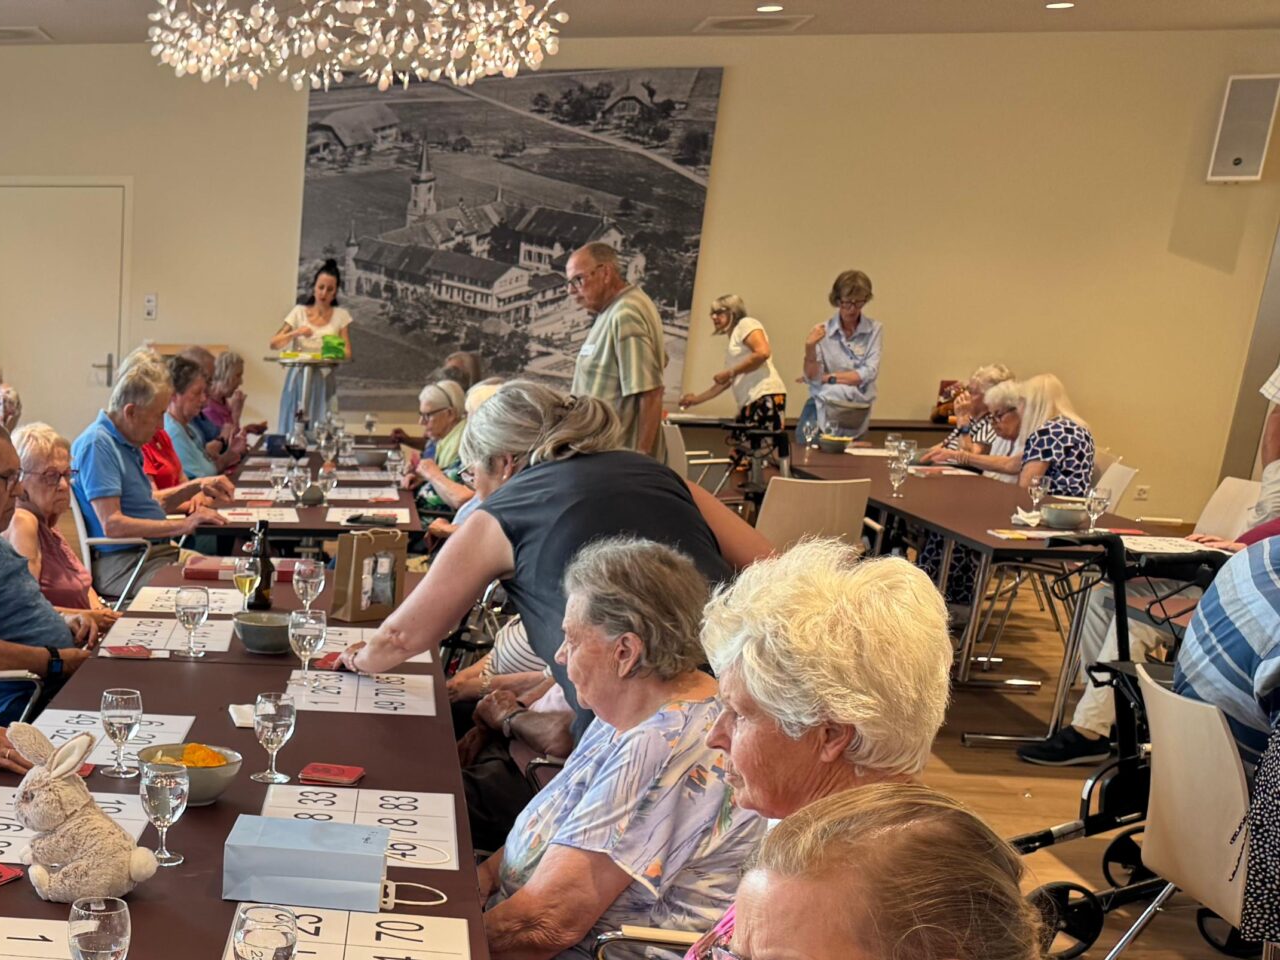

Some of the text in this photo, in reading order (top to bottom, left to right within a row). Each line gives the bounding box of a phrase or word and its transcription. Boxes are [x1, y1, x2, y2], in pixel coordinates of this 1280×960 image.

[373, 687, 407, 698] 70
[373, 700, 407, 711] 49
[65, 713, 100, 726] 49
[297, 790, 337, 807] 33
[378, 796, 419, 811] 83
[375, 920, 425, 943] 70
[6, 934, 54, 943] 1
